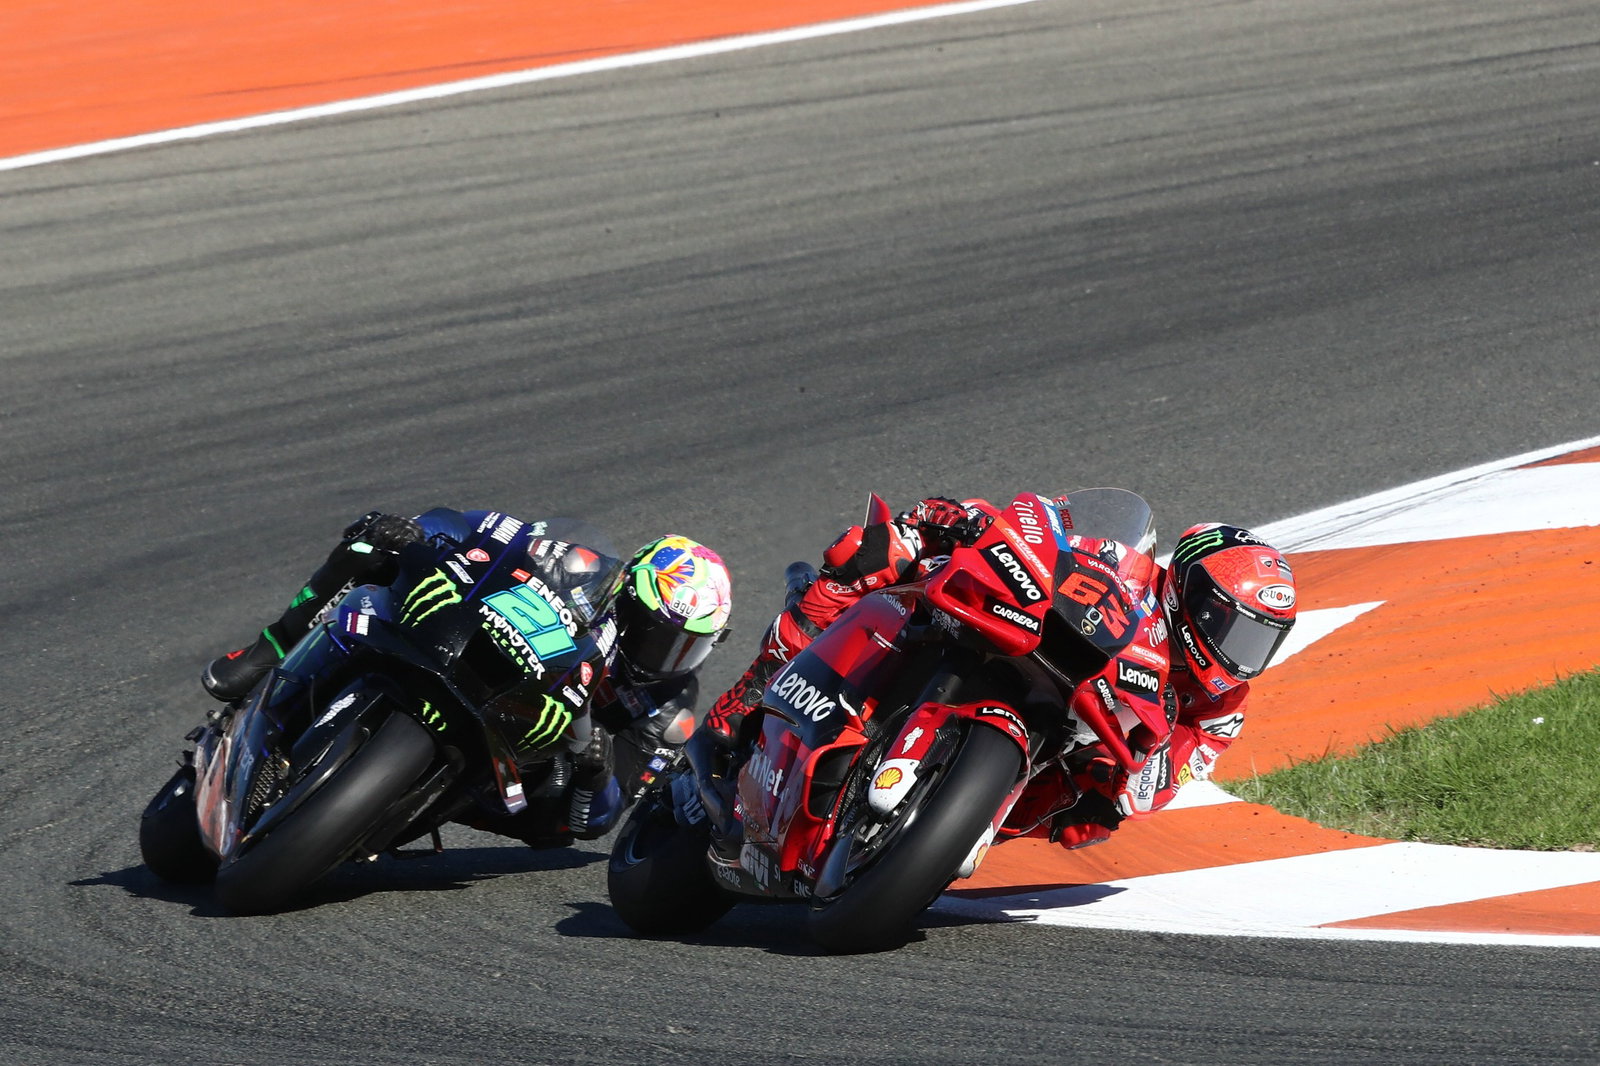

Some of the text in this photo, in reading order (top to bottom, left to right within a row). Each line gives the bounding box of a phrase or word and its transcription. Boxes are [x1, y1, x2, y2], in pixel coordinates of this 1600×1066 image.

[991, 543, 1041, 600] Lenovo
[480, 583, 578, 661] 21
[526, 576, 578, 637] ENEOS
[992, 604, 1039, 632] CARRERA
[1057, 572, 1130, 639] 63
[478, 605, 546, 680] MONSTER
[481, 621, 532, 674] ENERGY
[1181, 624, 1207, 667] Lenovo
[770, 661, 837, 722] Lenovo
[1119, 661, 1159, 692] Lenovo
